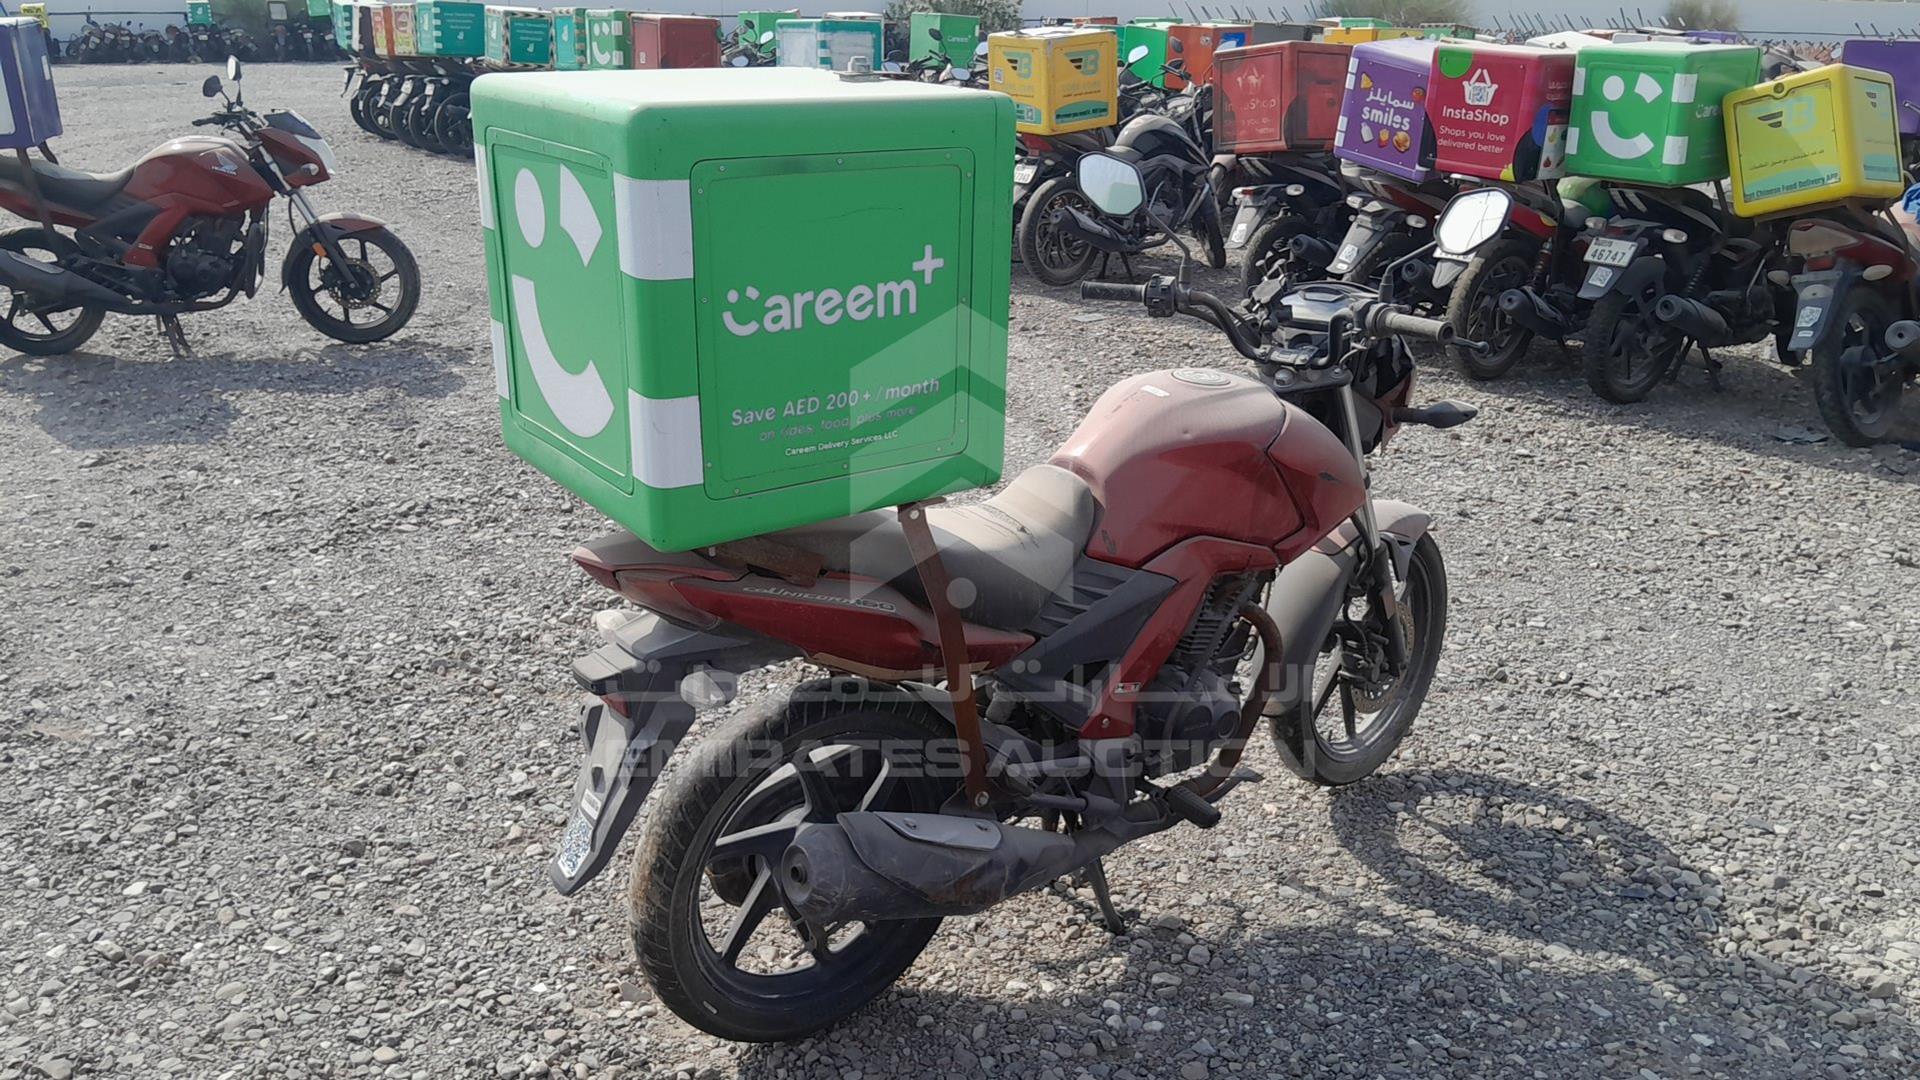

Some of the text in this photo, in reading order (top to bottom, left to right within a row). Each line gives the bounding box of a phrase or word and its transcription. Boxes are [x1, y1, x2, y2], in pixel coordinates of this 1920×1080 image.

[1361, 106, 1411, 131] smiles
[1442, 105, 1509, 126] InstaShop
[1439, 125, 1506, 142] Shops you love
[1437, 138, 1504, 154] delivered better
[1590, 248, 1626, 264] 46747
[731, 407, 777, 427] Save
[783, 397, 820, 417] AED
[785, 430, 899, 456] Careem Delivery Services LLC
